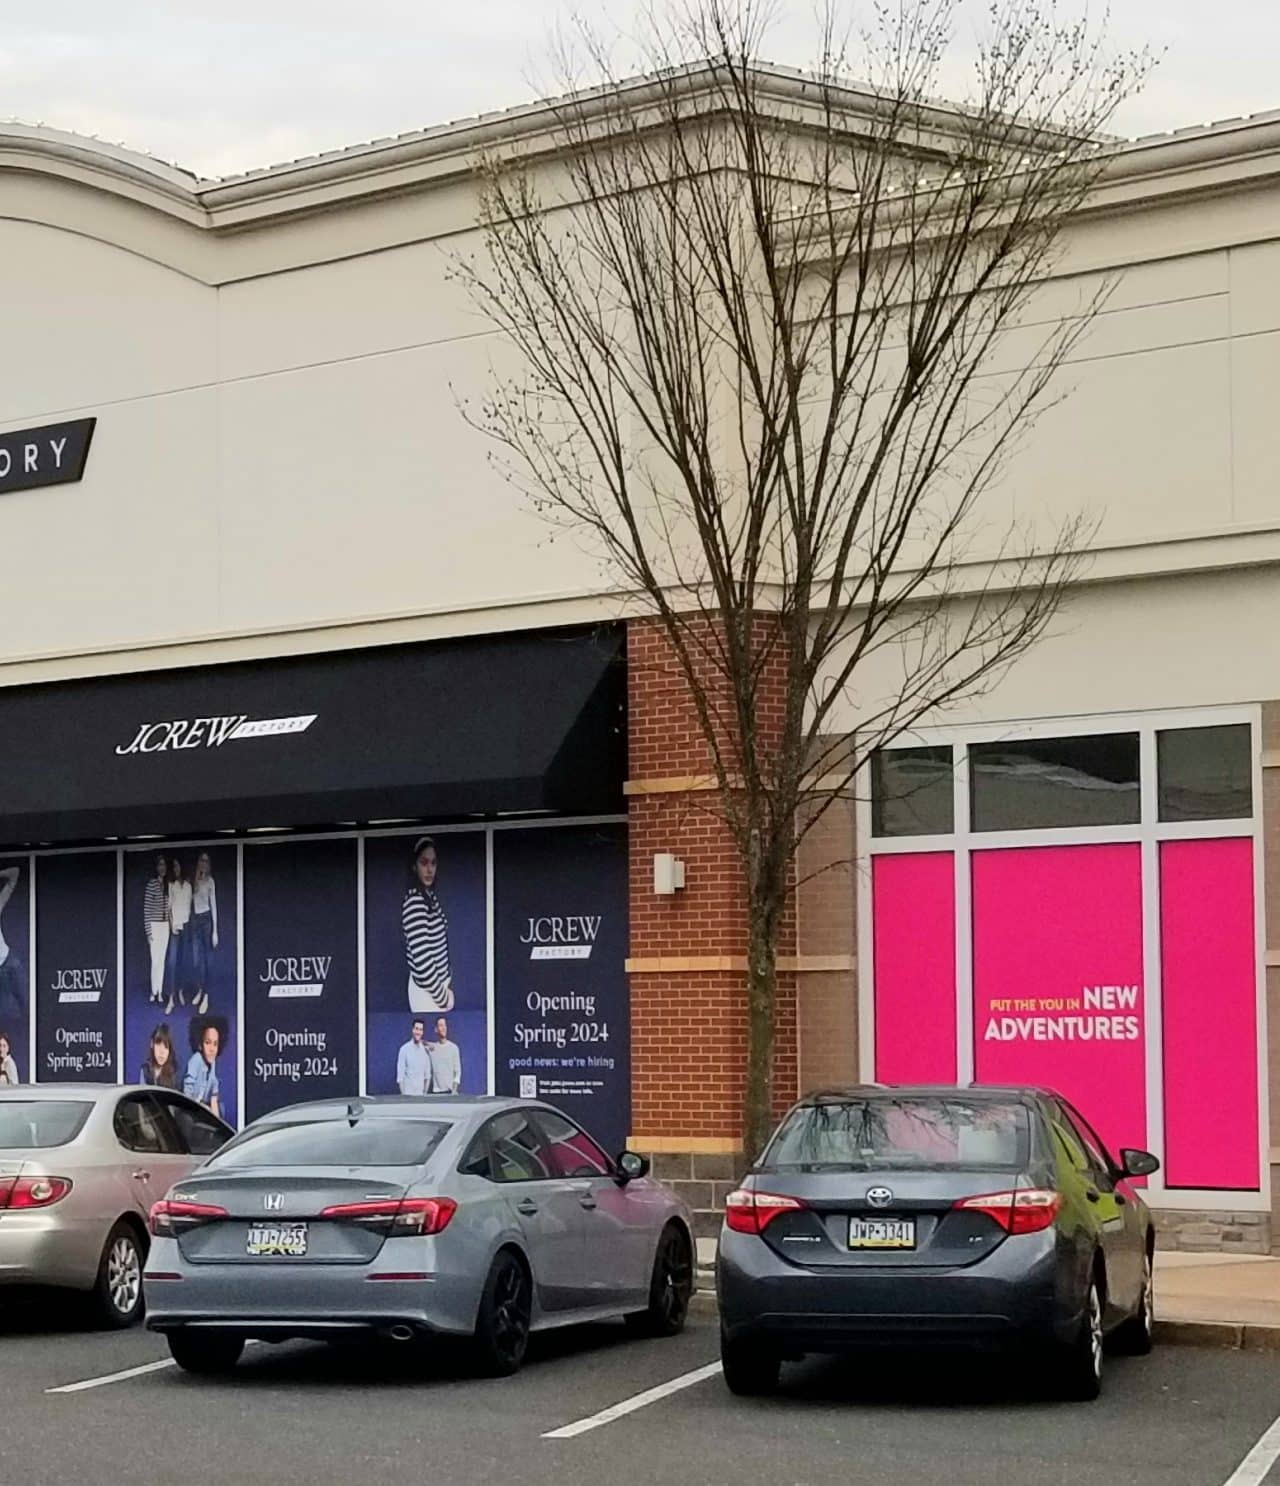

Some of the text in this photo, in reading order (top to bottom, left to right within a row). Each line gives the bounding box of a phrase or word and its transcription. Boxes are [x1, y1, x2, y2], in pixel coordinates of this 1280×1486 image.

[116, 714, 306, 755] J.CREW FACTORY
[519, 915, 602, 944] J.CREW
[50, 968, 108, 990] J.CREW
[259, 955, 332, 982] J.CREW
[526, 990, 596, 1018] Opening
[990, 985, 1139, 1012] PUT THE YOU IN NEW
[55, 1027, 103, 1048] Opening
[265, 1028, 327, 1053] Opening
[514, 1022, 609, 1049] Spring 2024
[984, 1015, 1140, 1041] ADVENTURES
[47, 1051, 112, 1072] Spring 2024
[254, 1057, 338, 1082] Spring 2024
[509, 1056, 615, 1070] good news: we're hiring
